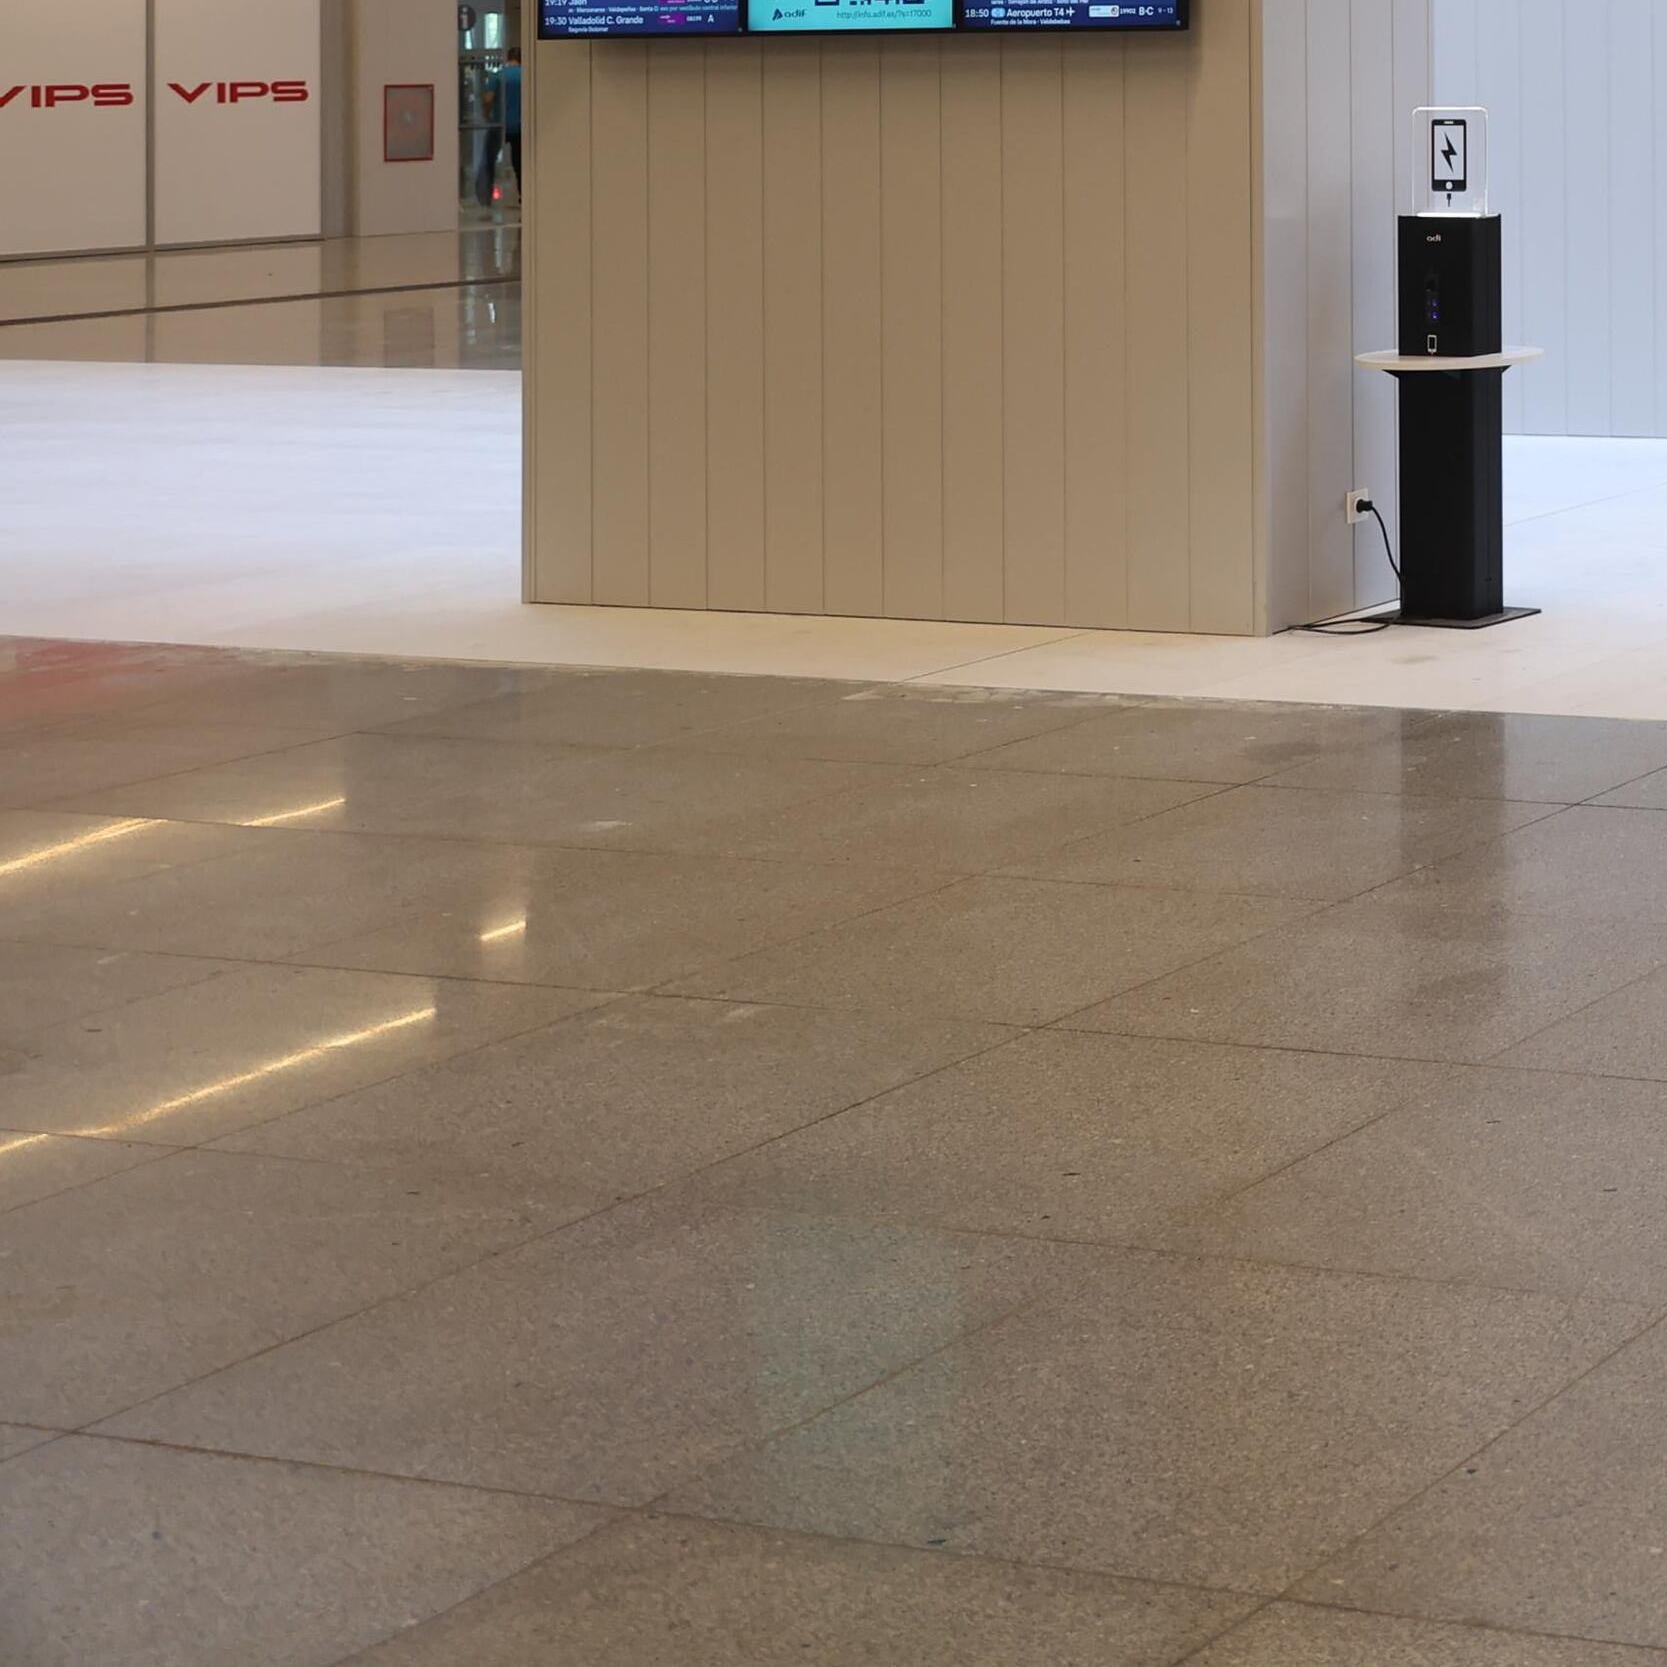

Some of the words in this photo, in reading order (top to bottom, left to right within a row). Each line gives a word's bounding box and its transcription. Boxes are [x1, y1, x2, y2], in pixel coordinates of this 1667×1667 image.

[785, 9, 807, 19] adif
[965, 8, 989, 18] 18:50
[1007, 7, 1053, 19] Aeropuerto
[1054, 7, 1065, 16] T4
[545, 16, 567, 25] 19:30
[568, 16, 605, 25] Valladolid
[615, 15, 643, 24] Grande
[167, 80, 309, 104] VIPS
